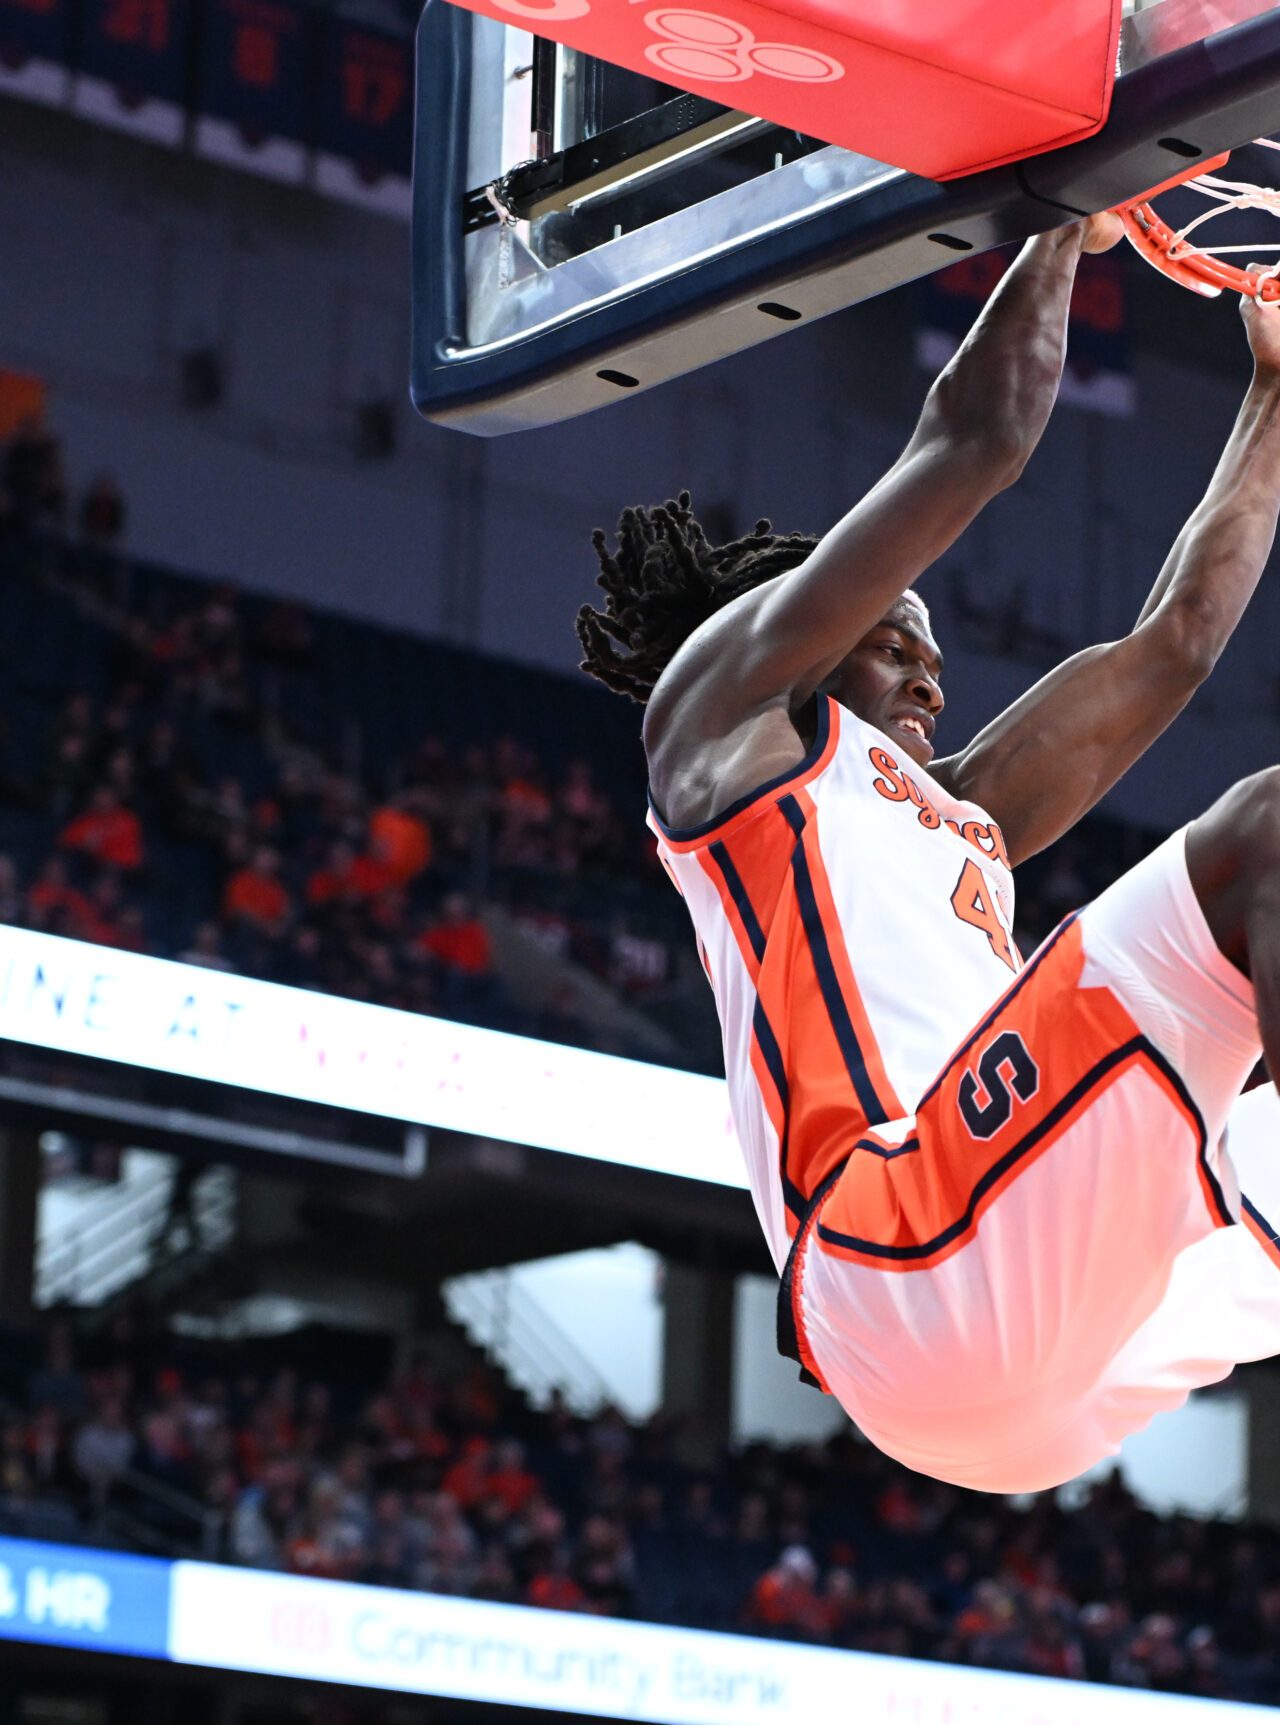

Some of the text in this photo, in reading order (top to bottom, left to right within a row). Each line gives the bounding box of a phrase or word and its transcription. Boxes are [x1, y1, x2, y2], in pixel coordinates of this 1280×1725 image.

[165, 992, 247, 1056] AT
[957, 1029, 1040, 1142] S
[25, 1566, 111, 1633] HR
[349, 1608, 658, 1715] Community
[673, 1650, 790, 1710] Bank
